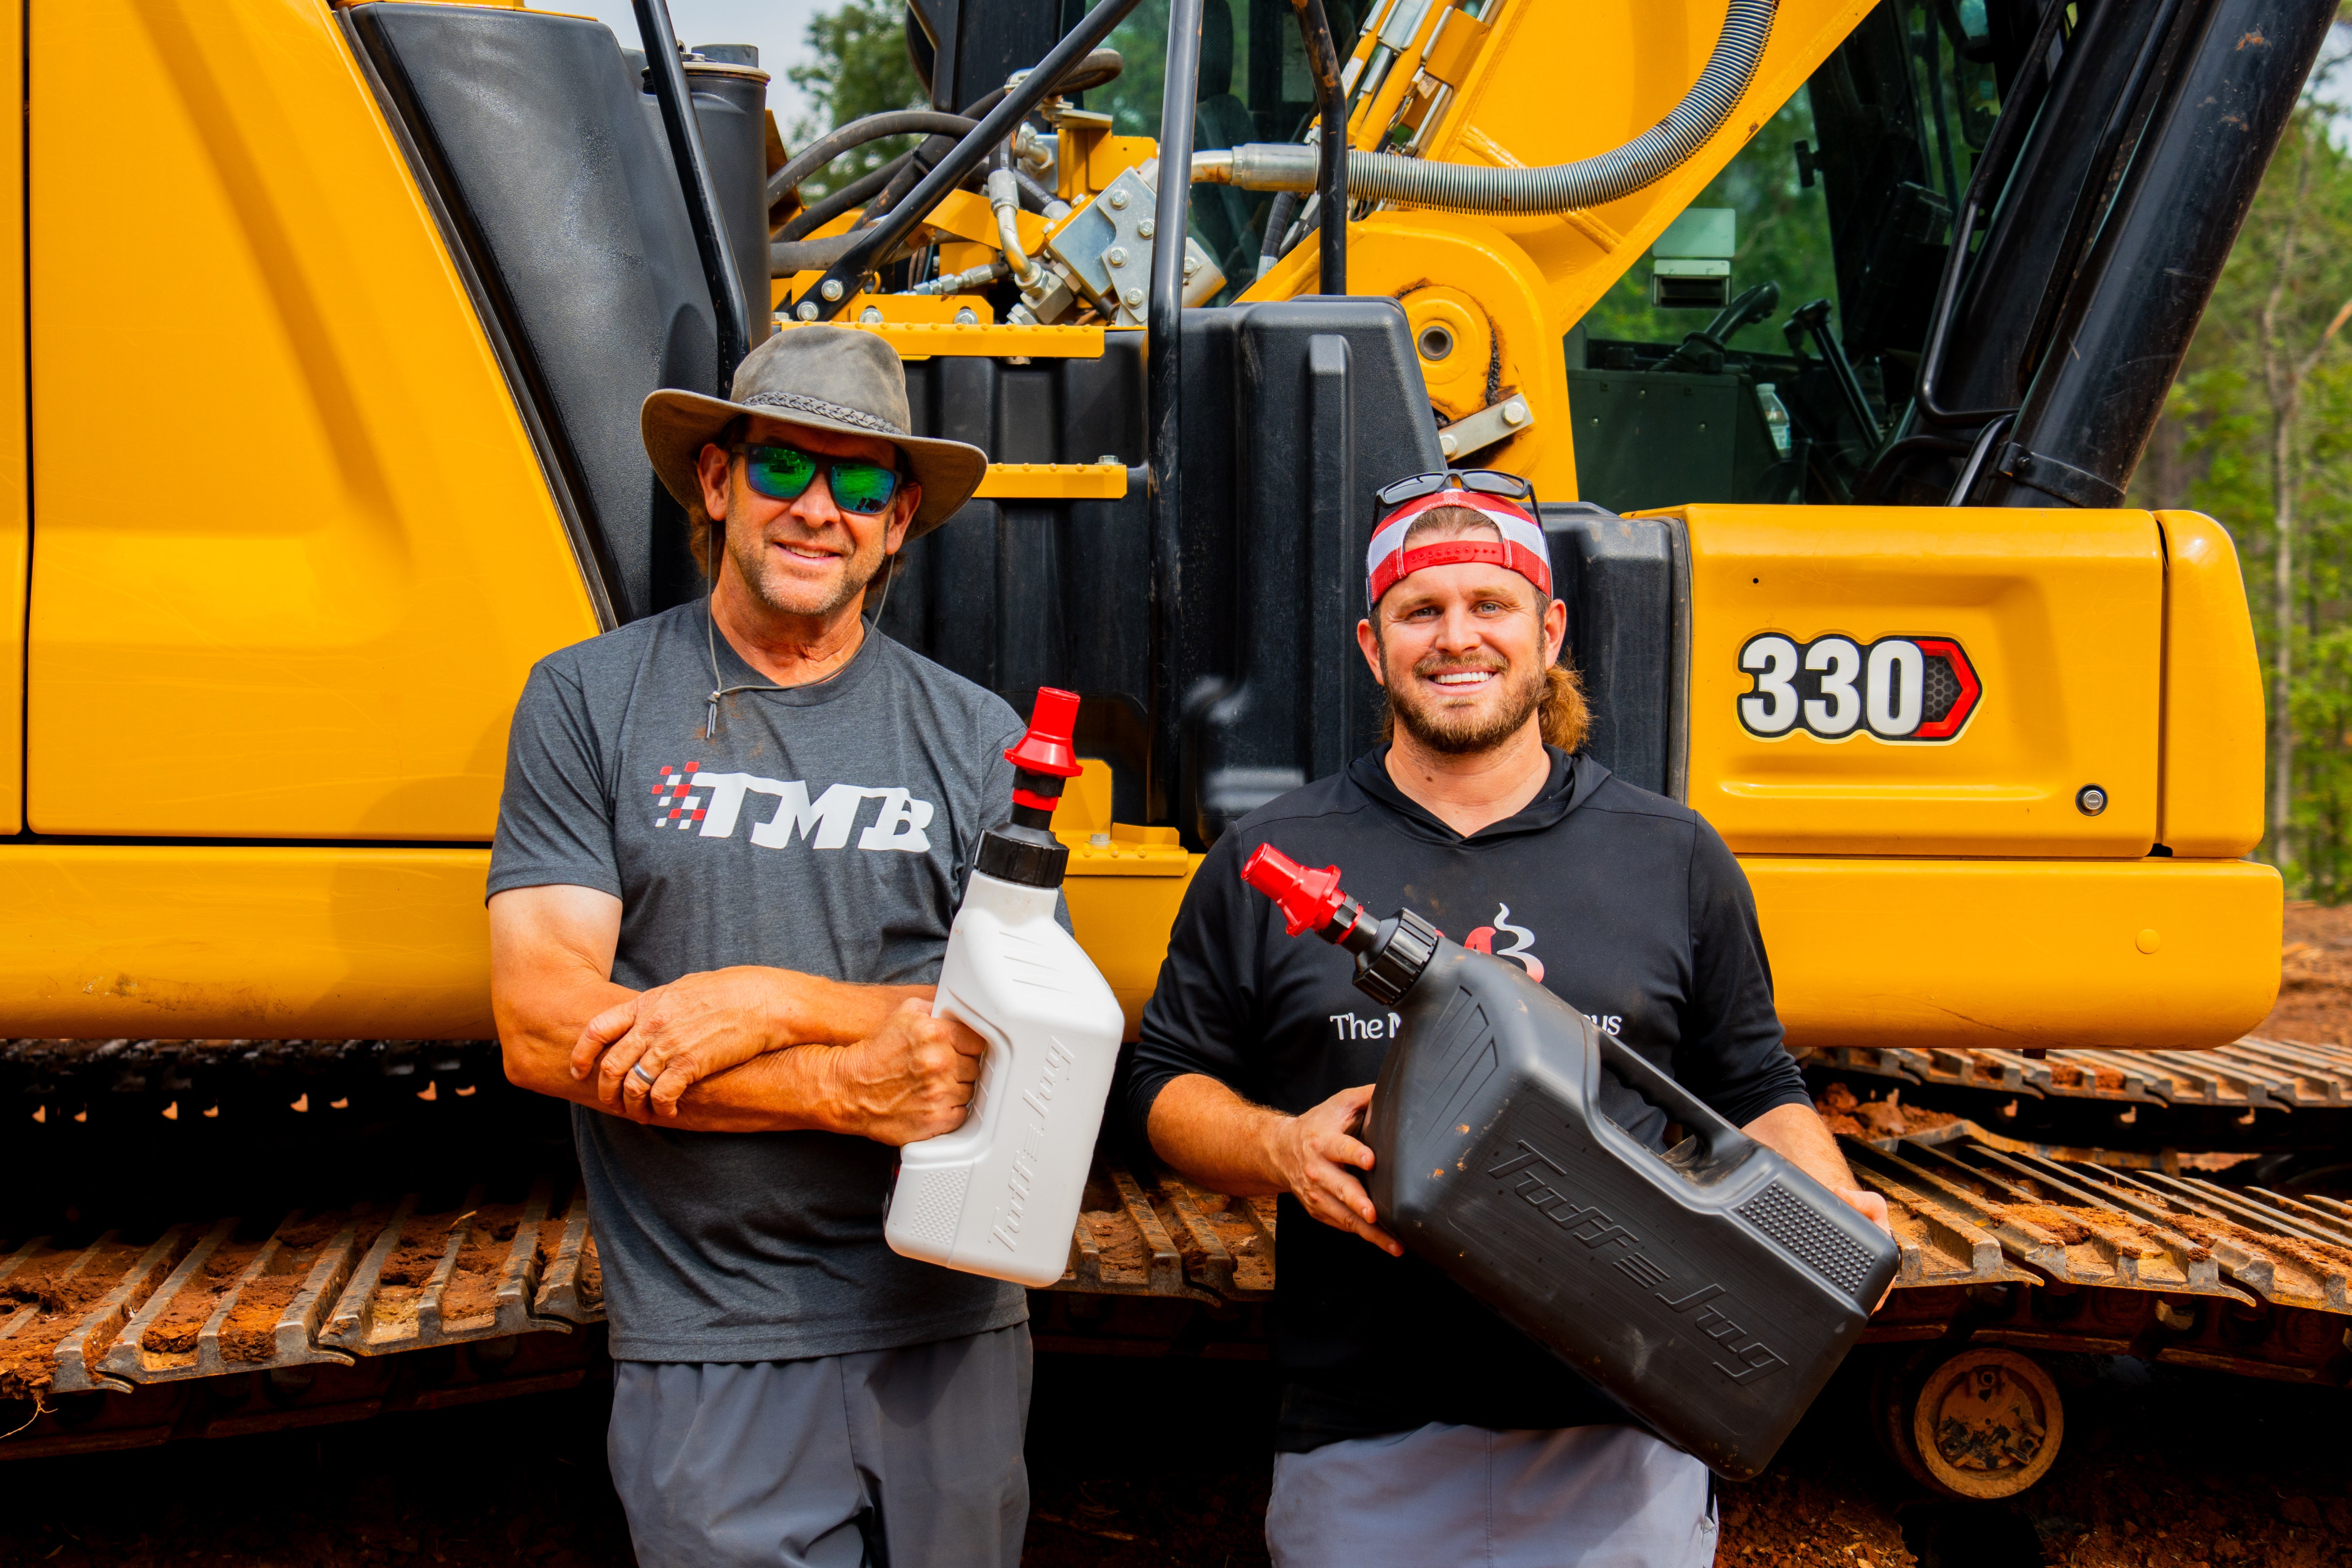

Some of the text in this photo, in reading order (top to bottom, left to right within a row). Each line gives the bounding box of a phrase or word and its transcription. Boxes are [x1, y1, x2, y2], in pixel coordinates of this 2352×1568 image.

[1742, 637, 1924, 735] 330
[690, 772, 934, 852] TMB
[1330, 1012, 1384, 1040] The
[988, 1036, 1075, 1252] Tuff Jug
[1488, 1140, 1789, 1386] Tuff Jug
